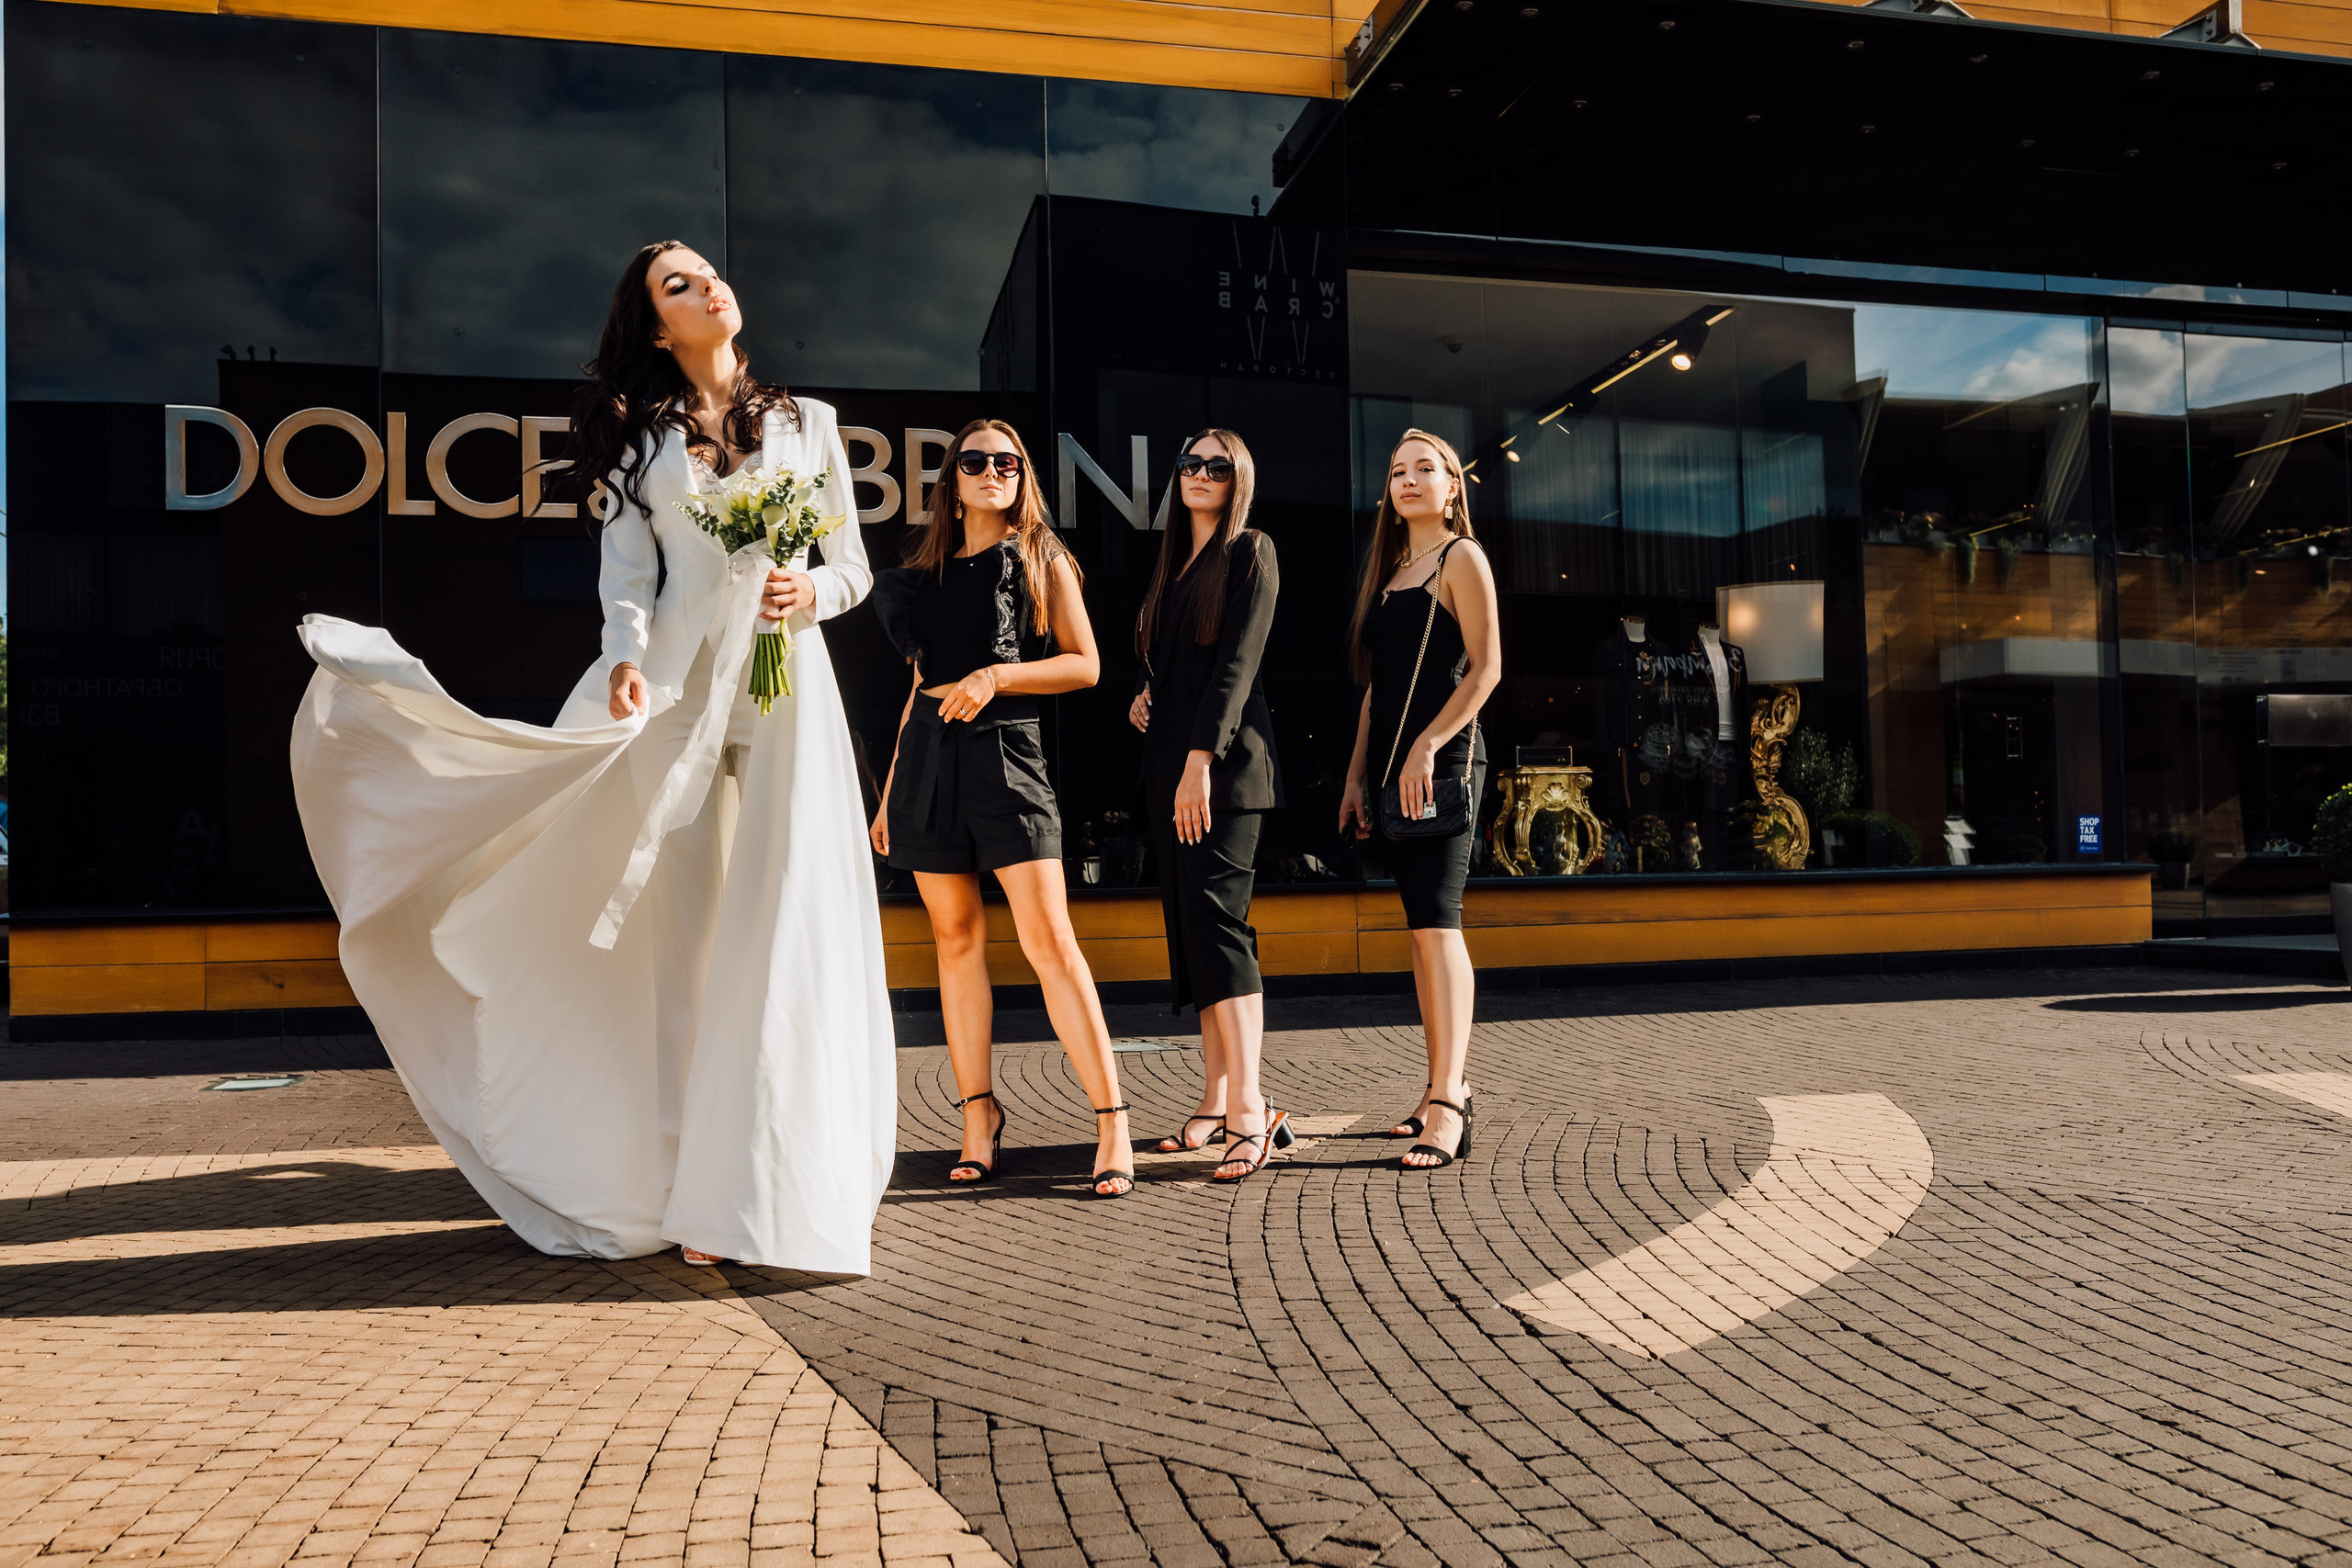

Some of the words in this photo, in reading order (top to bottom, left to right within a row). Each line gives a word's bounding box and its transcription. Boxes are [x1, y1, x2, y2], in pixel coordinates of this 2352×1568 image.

[2079, 817, 2099, 826] SHOP
[2079, 826, 2095, 834] TAX
[2079, 834, 2098, 843] FREE
